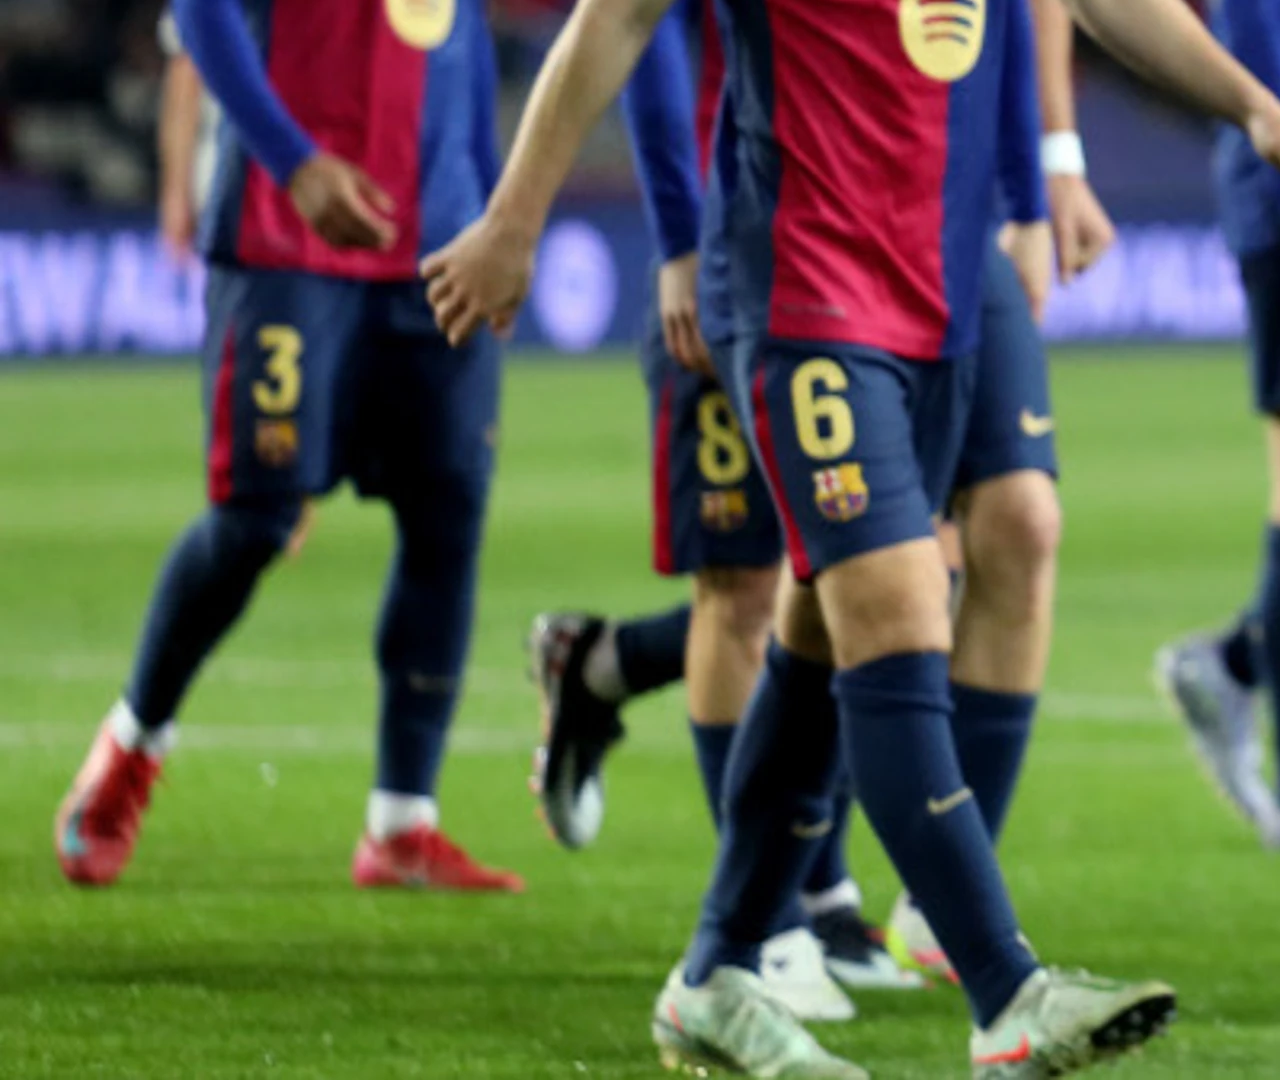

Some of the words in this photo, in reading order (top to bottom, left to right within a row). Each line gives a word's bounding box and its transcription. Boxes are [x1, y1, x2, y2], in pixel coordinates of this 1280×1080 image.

[252, 325, 303, 413] 3
[791, 357, 856, 460] 6
[698, 391, 749, 485] 8
